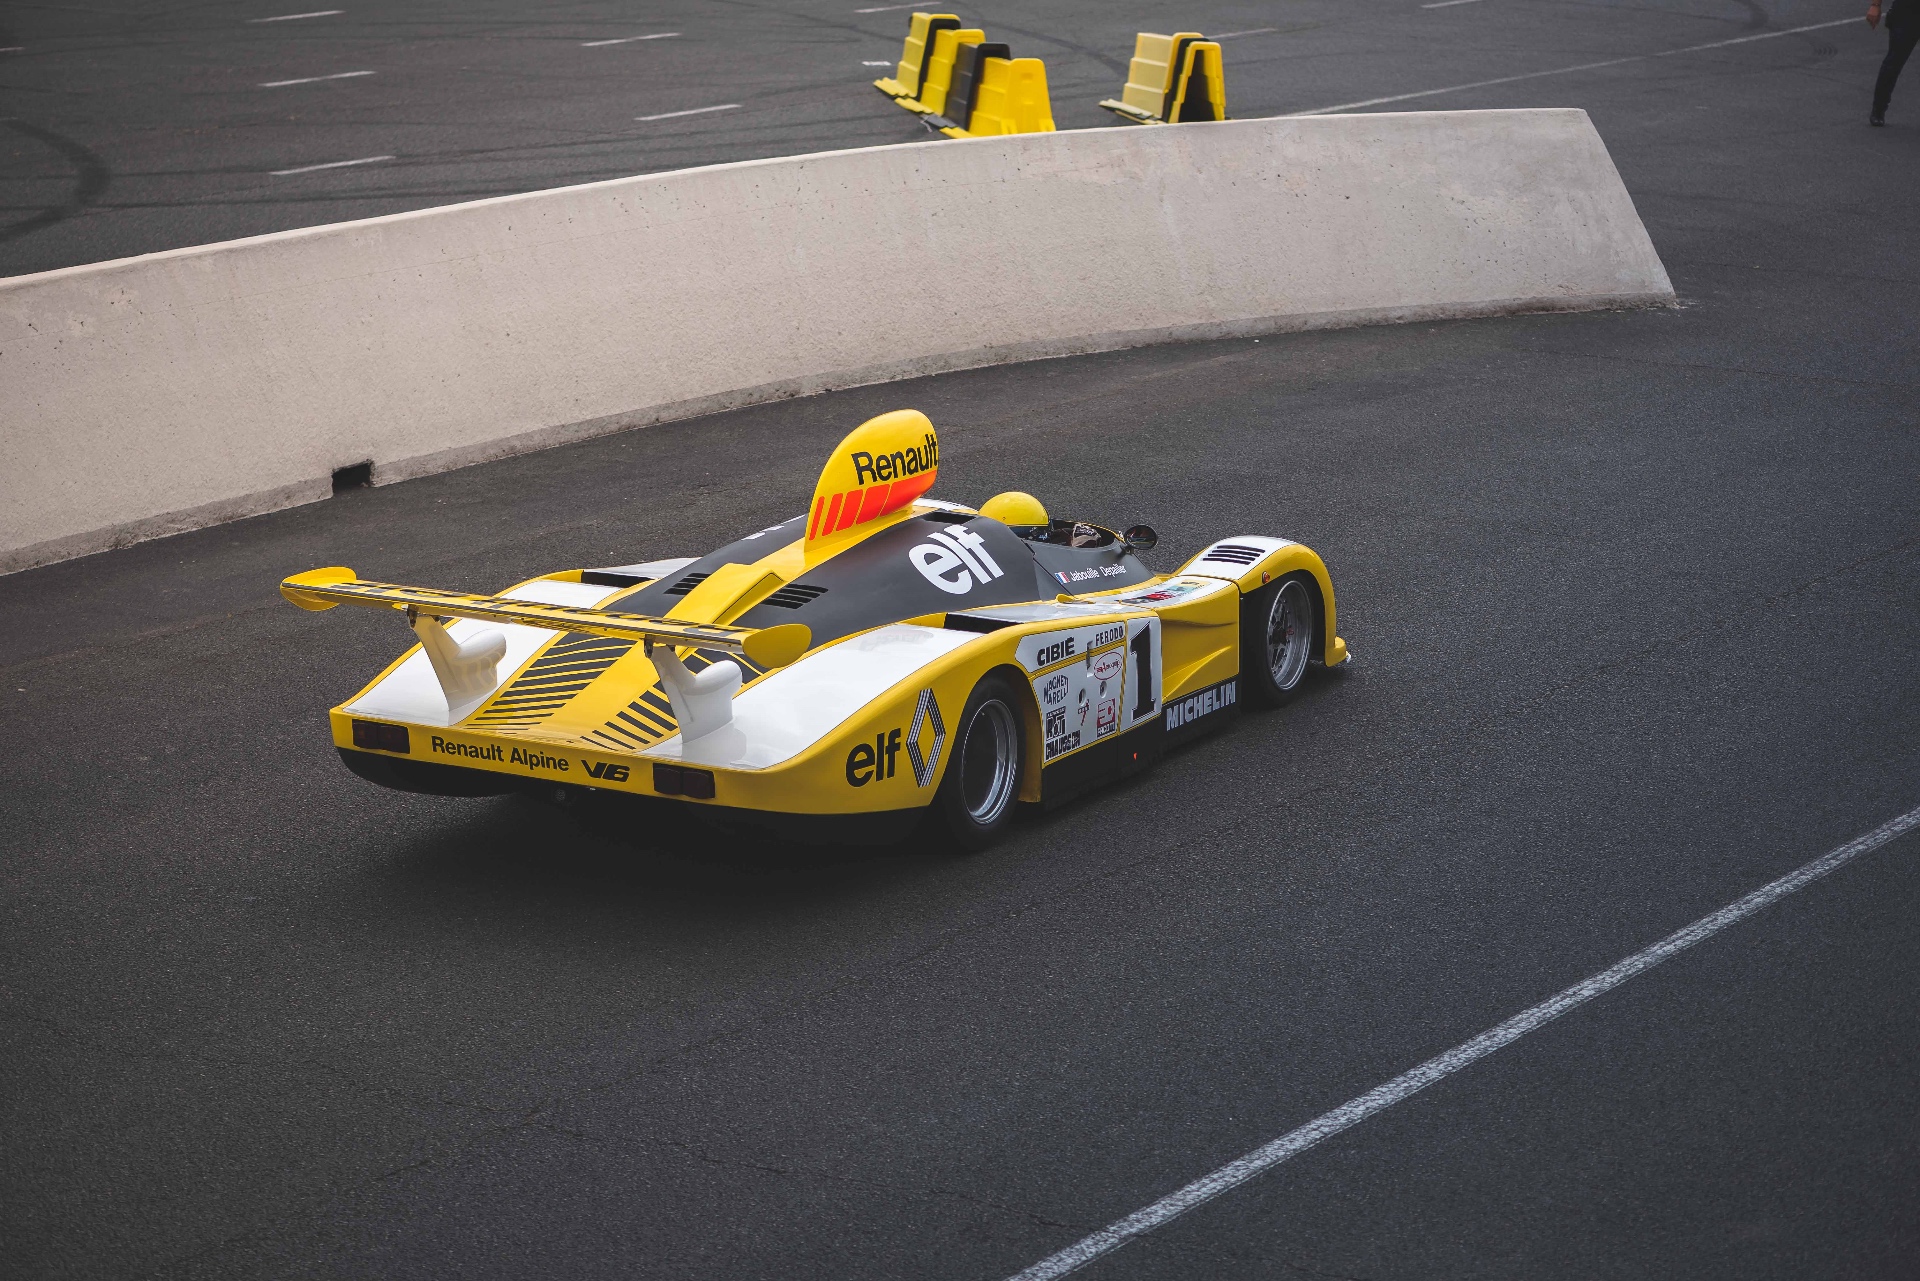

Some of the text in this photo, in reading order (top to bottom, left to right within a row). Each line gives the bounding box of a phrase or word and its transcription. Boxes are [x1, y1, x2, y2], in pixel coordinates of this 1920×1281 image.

[851, 433, 938, 485] Renault
[908, 524, 1004, 595] elf
[1095, 625, 1124, 646] FERODO
[1130, 621, 1156, 723] 1
[1166, 680, 1237, 732] MICHELIN
[431, 735, 631, 783] Renault Alpine V6
[845, 727, 901, 788] elf
